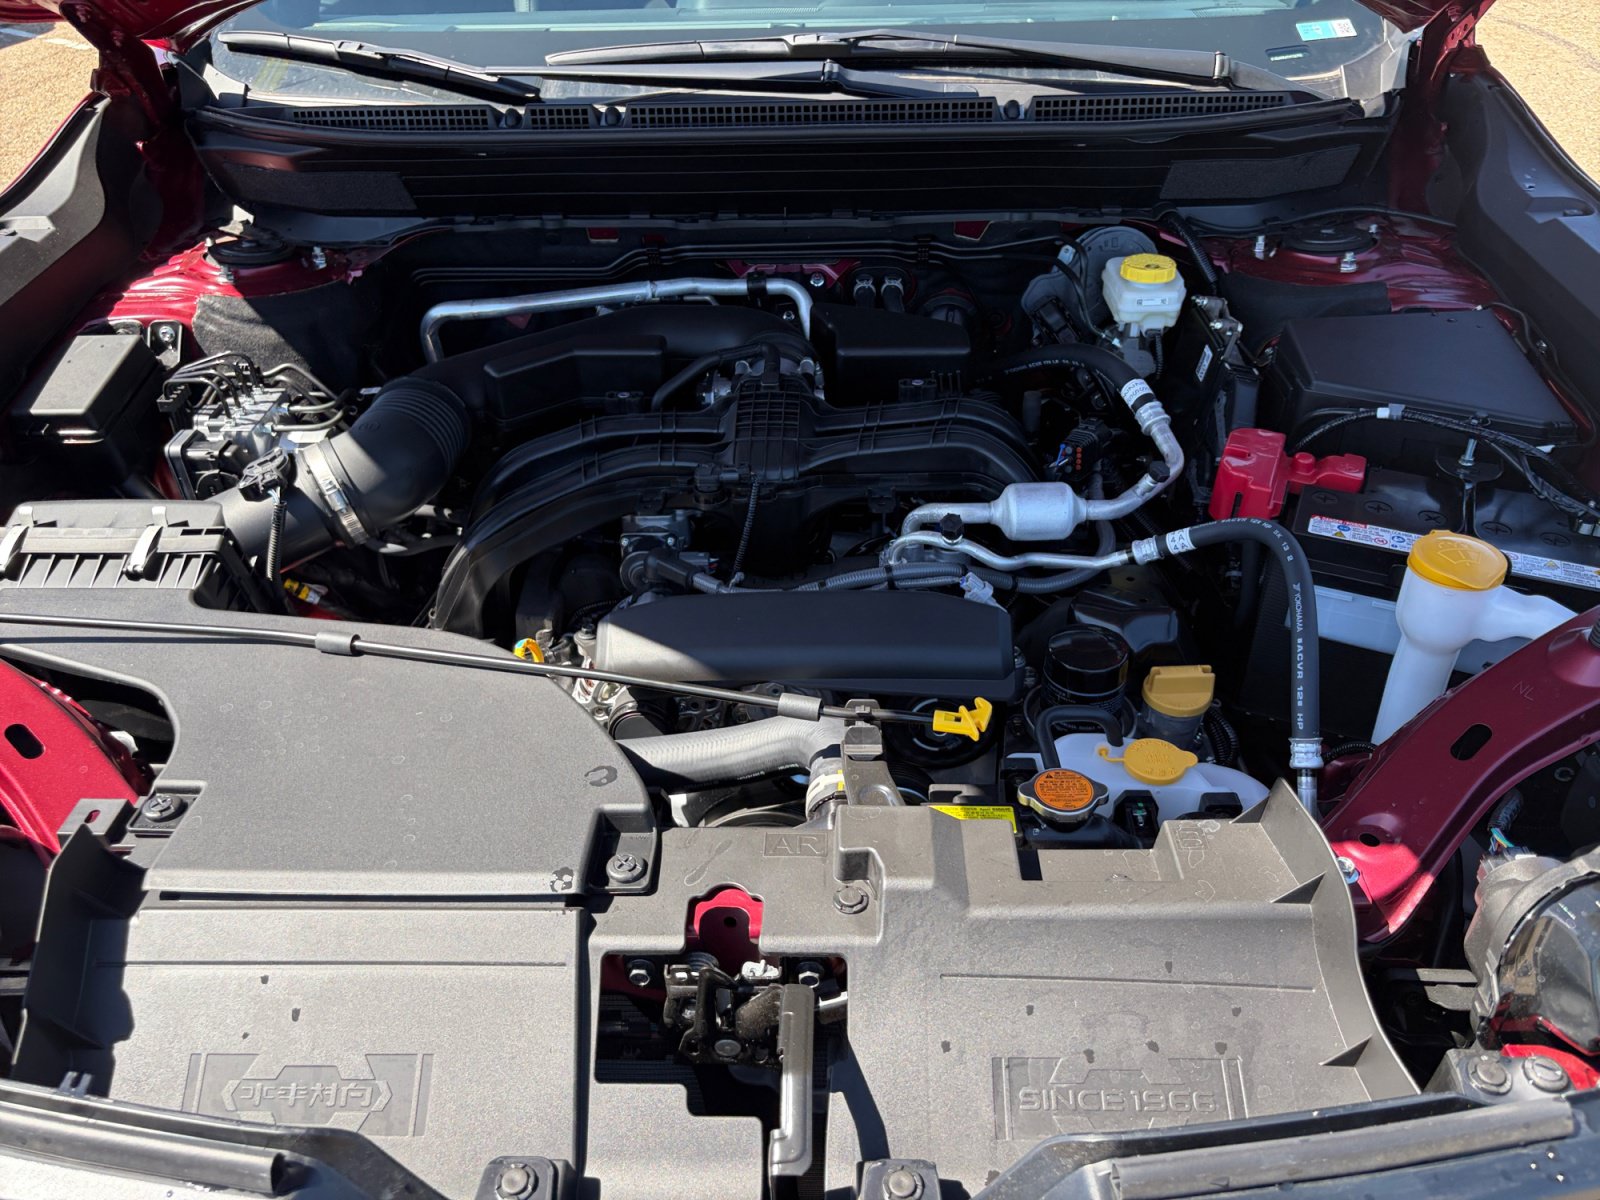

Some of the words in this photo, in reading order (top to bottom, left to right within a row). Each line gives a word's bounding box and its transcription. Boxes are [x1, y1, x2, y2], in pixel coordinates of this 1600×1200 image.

[1294, 593, 1304, 633] YOKOHAMA
[1296, 713, 1304, 730] HP
[768, 835, 825, 855] AR
[1018, 1086, 1126, 1112] SINCE
[1129, 1088, 1217, 1113] 1966
